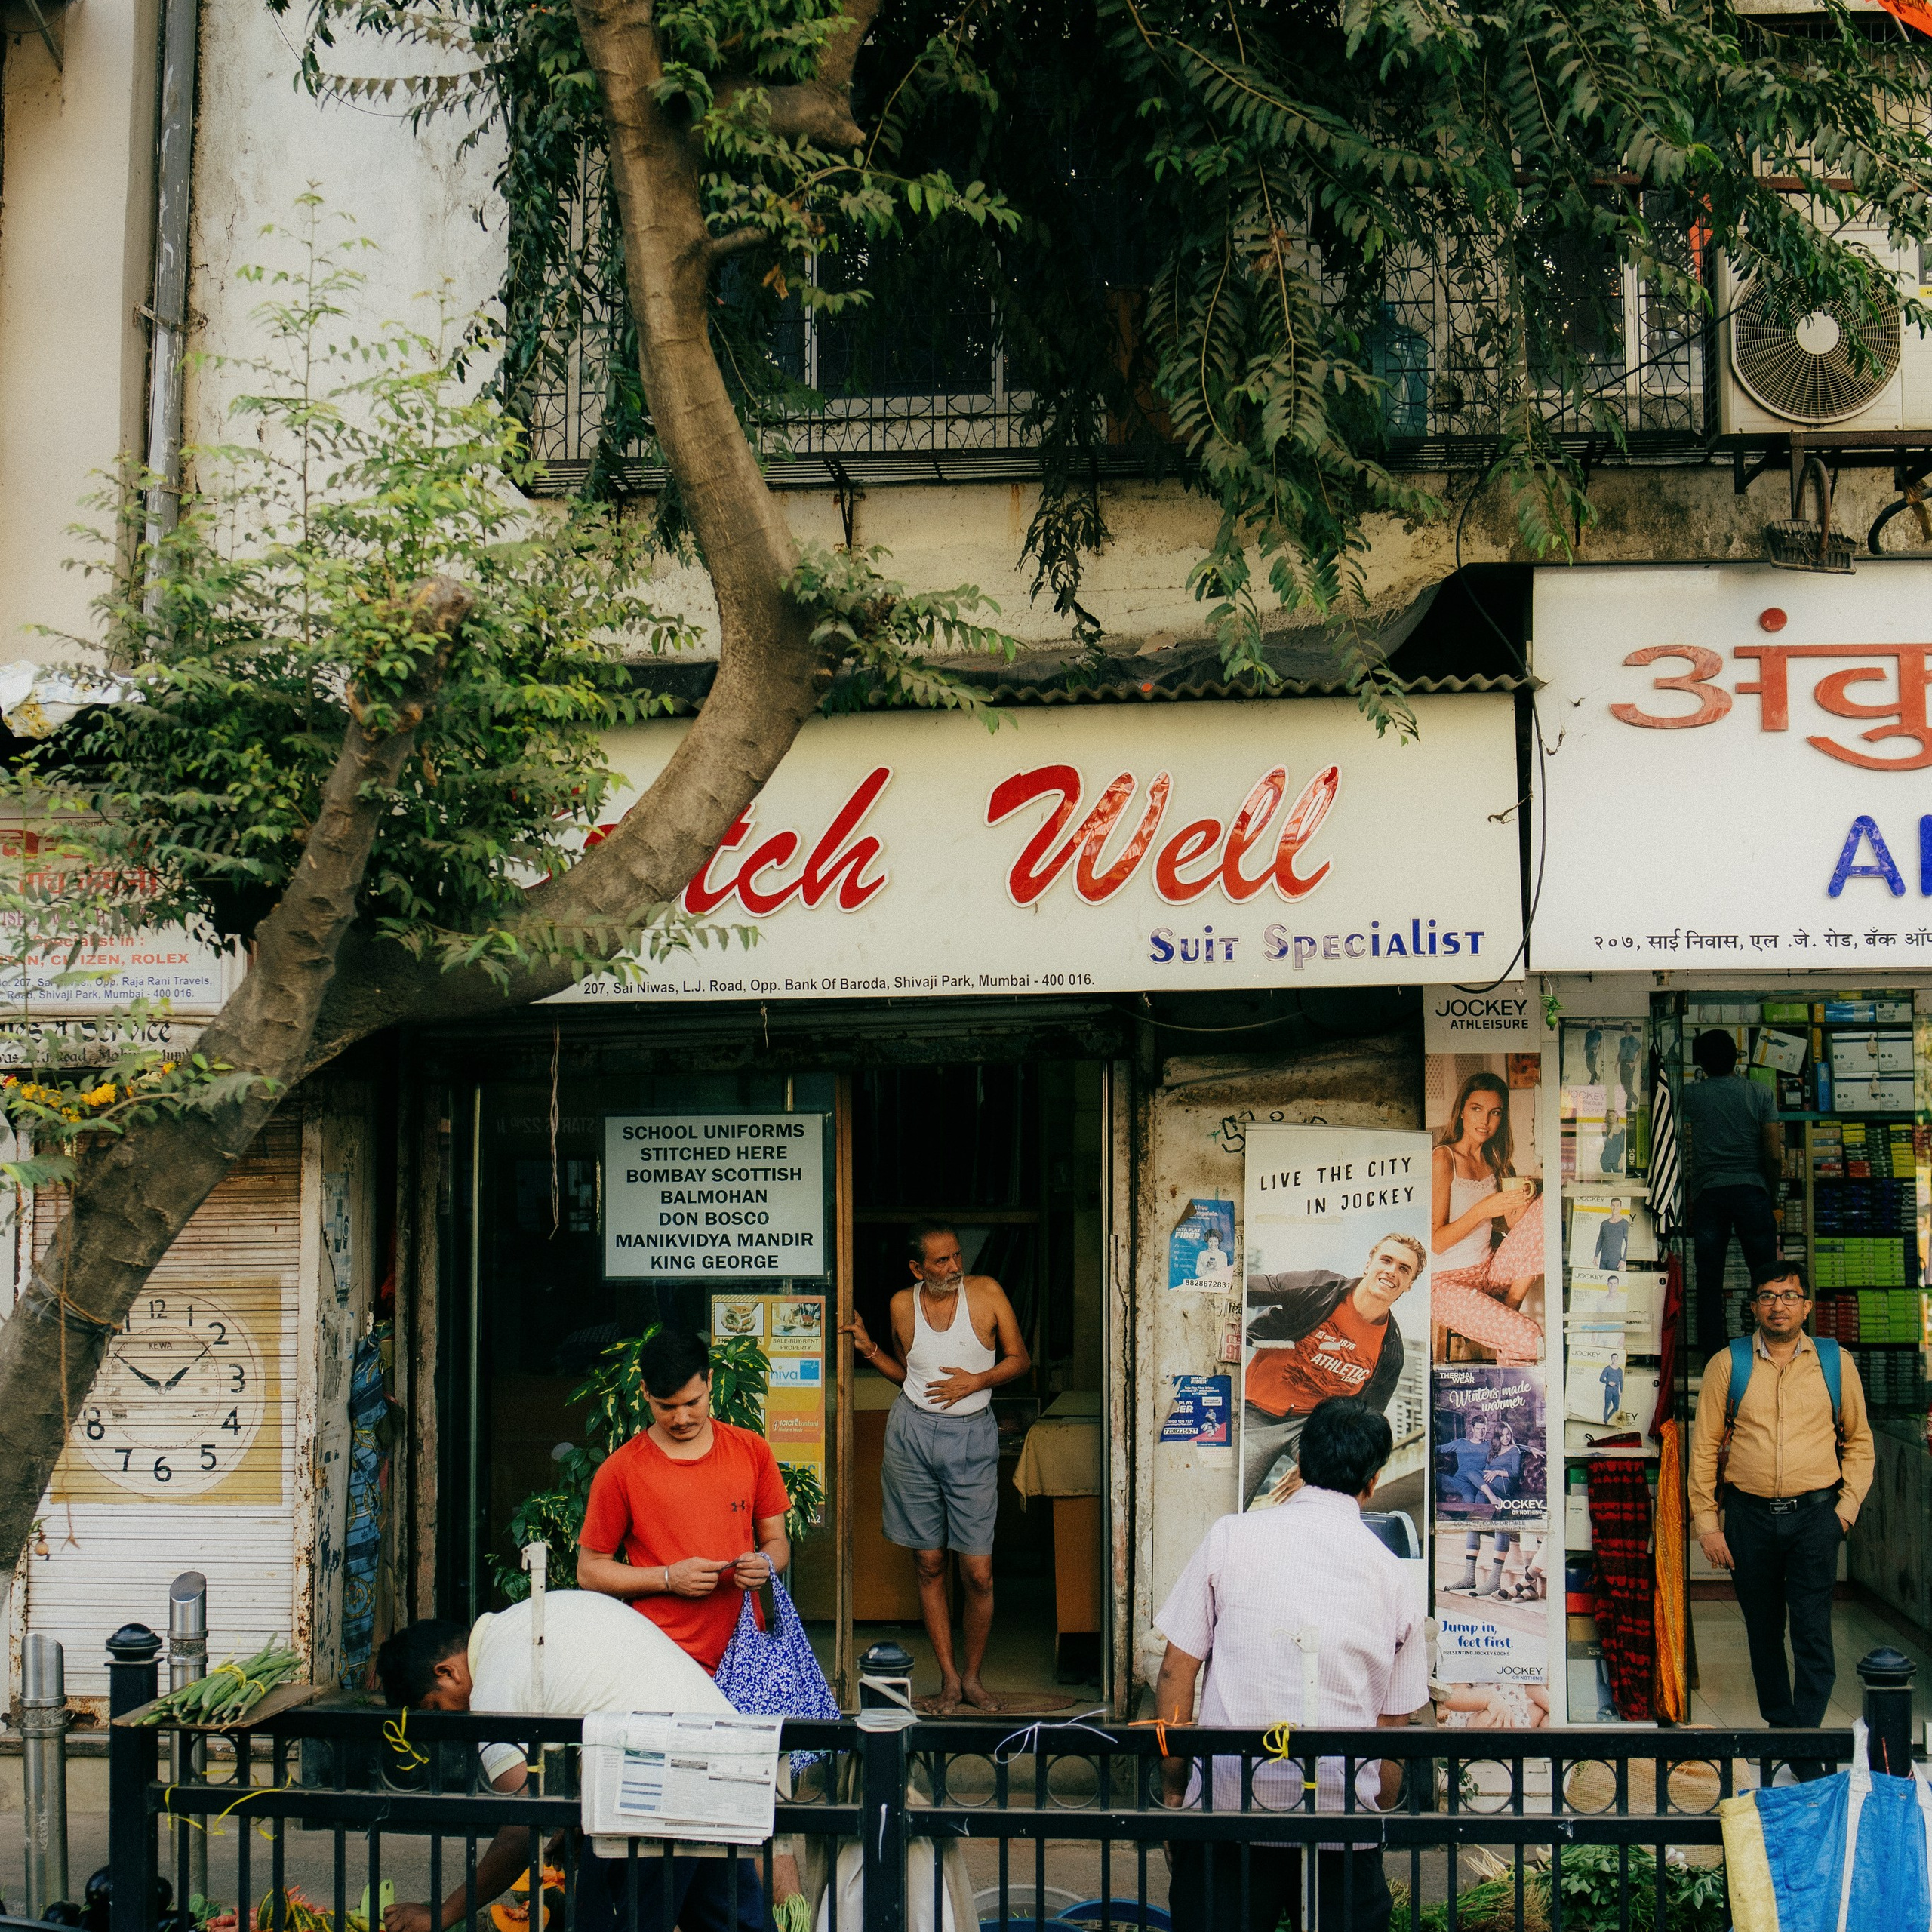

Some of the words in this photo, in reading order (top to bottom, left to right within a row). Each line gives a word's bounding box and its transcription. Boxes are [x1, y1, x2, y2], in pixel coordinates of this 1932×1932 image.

[983, 761, 1342, 907] Well
[1594, 935, 1641, 952] २०७,
[1646, 928, 1681, 951] साई
[1685, 929, 1744, 952] निवास,
[1823, 928, 1858, 949] रोड,
[131, 953, 189, 964] ROLEX
[122, 977, 144, 987] Raja
[148, 976, 170, 985] Rani
[174, 976, 212, 986] Travels,
[583, 983, 610, 997] 207,
[614, 980, 633, 995] Sai
[637, 981, 678, 995] Niwas,
[683, 980, 706, 993] L.J.
[709, 979, 746, 993] Road,
[750, 979, 781, 994] Opp.
[785, 978, 817, 991] Bank
[821, 977, 837, 990] Of
[840, 977, 890, 991] Baroda,
[894, 975, 937, 990] Shivaji
[942, 974, 975, 989] Park,
[979, 974, 1029, 987] Mumbai
[1041, 974, 1065, 986] 400
[1069, 973, 1094, 986] 016.
[38, 989, 72, 1001] Shivaji
[75, 989, 100, 1000] Park,
[104, 989, 143, 998] Mumbai
[153, 989, 171, 998] 400
[174, 989, 195, 998] 016.
[1435, 999, 1527, 1017] JOCKEY
[1451, 1019, 1528, 1029] ATHLEISURE
[623, 1125, 698, 1140] SCHOOL
[703, 1124, 805, 1139] UNIFORMS
[640, 1147, 731, 1161] STITCHED
[737, 1146, 787, 1160] HERE
[626, 1168, 707, 1183] BOMBAY
[712, 1167, 802, 1183] SCOTTISH
[1260, 1171, 1301, 1191] LIVE
[1317, 1164, 1352, 1183] THE
[1367, 1157, 1411, 1177] CITY
[660, 1189, 768, 1204] BALMOHAN
[1307, 1197, 1326, 1214] IN
[1341, 1186, 1414, 1211] JOCKEY
[659, 1212, 698, 1226] DON
[705, 1211, 770, 1226] BOSCO
[615, 1233, 731, 1248] MANIKVIDYA
[737, 1232, 814, 1247] MANDIR
[651, 1255, 696, 1269] KING
[702, 1254, 779, 1269] GEORGE
[149, 1299, 168, 1319] 12
[186, 1304, 193, 1327] 1
[208, 1322, 229, 1345] 2
[770, 1365, 798, 1380] niva
[1310, 1353, 1371, 1380] ATHLETIC
[229, 1364, 245, 1392] 3
[1449, 1386, 1500, 1408] Winters
[1502, 1380, 1532, 1395] made
[1481, 1395, 1526, 1412] warmer
[83, 1407, 106, 1440] 8
[221, 1406, 242, 1435] 4
[115, 1448, 133, 1472] 7
[201, 1444, 217, 1470] 5
[153, 1456, 172, 1482] 6
[1494, 1500, 1543, 1509] JOCKEY
[1442, 1620, 1478, 1635] Jump
[1481, 1621, 1497, 1635] in,
[1458, 1635, 1481, 1648] feet
[1484, 1636, 1514, 1648] first.
[1497, 1666, 1543, 1675] JOCKEY
